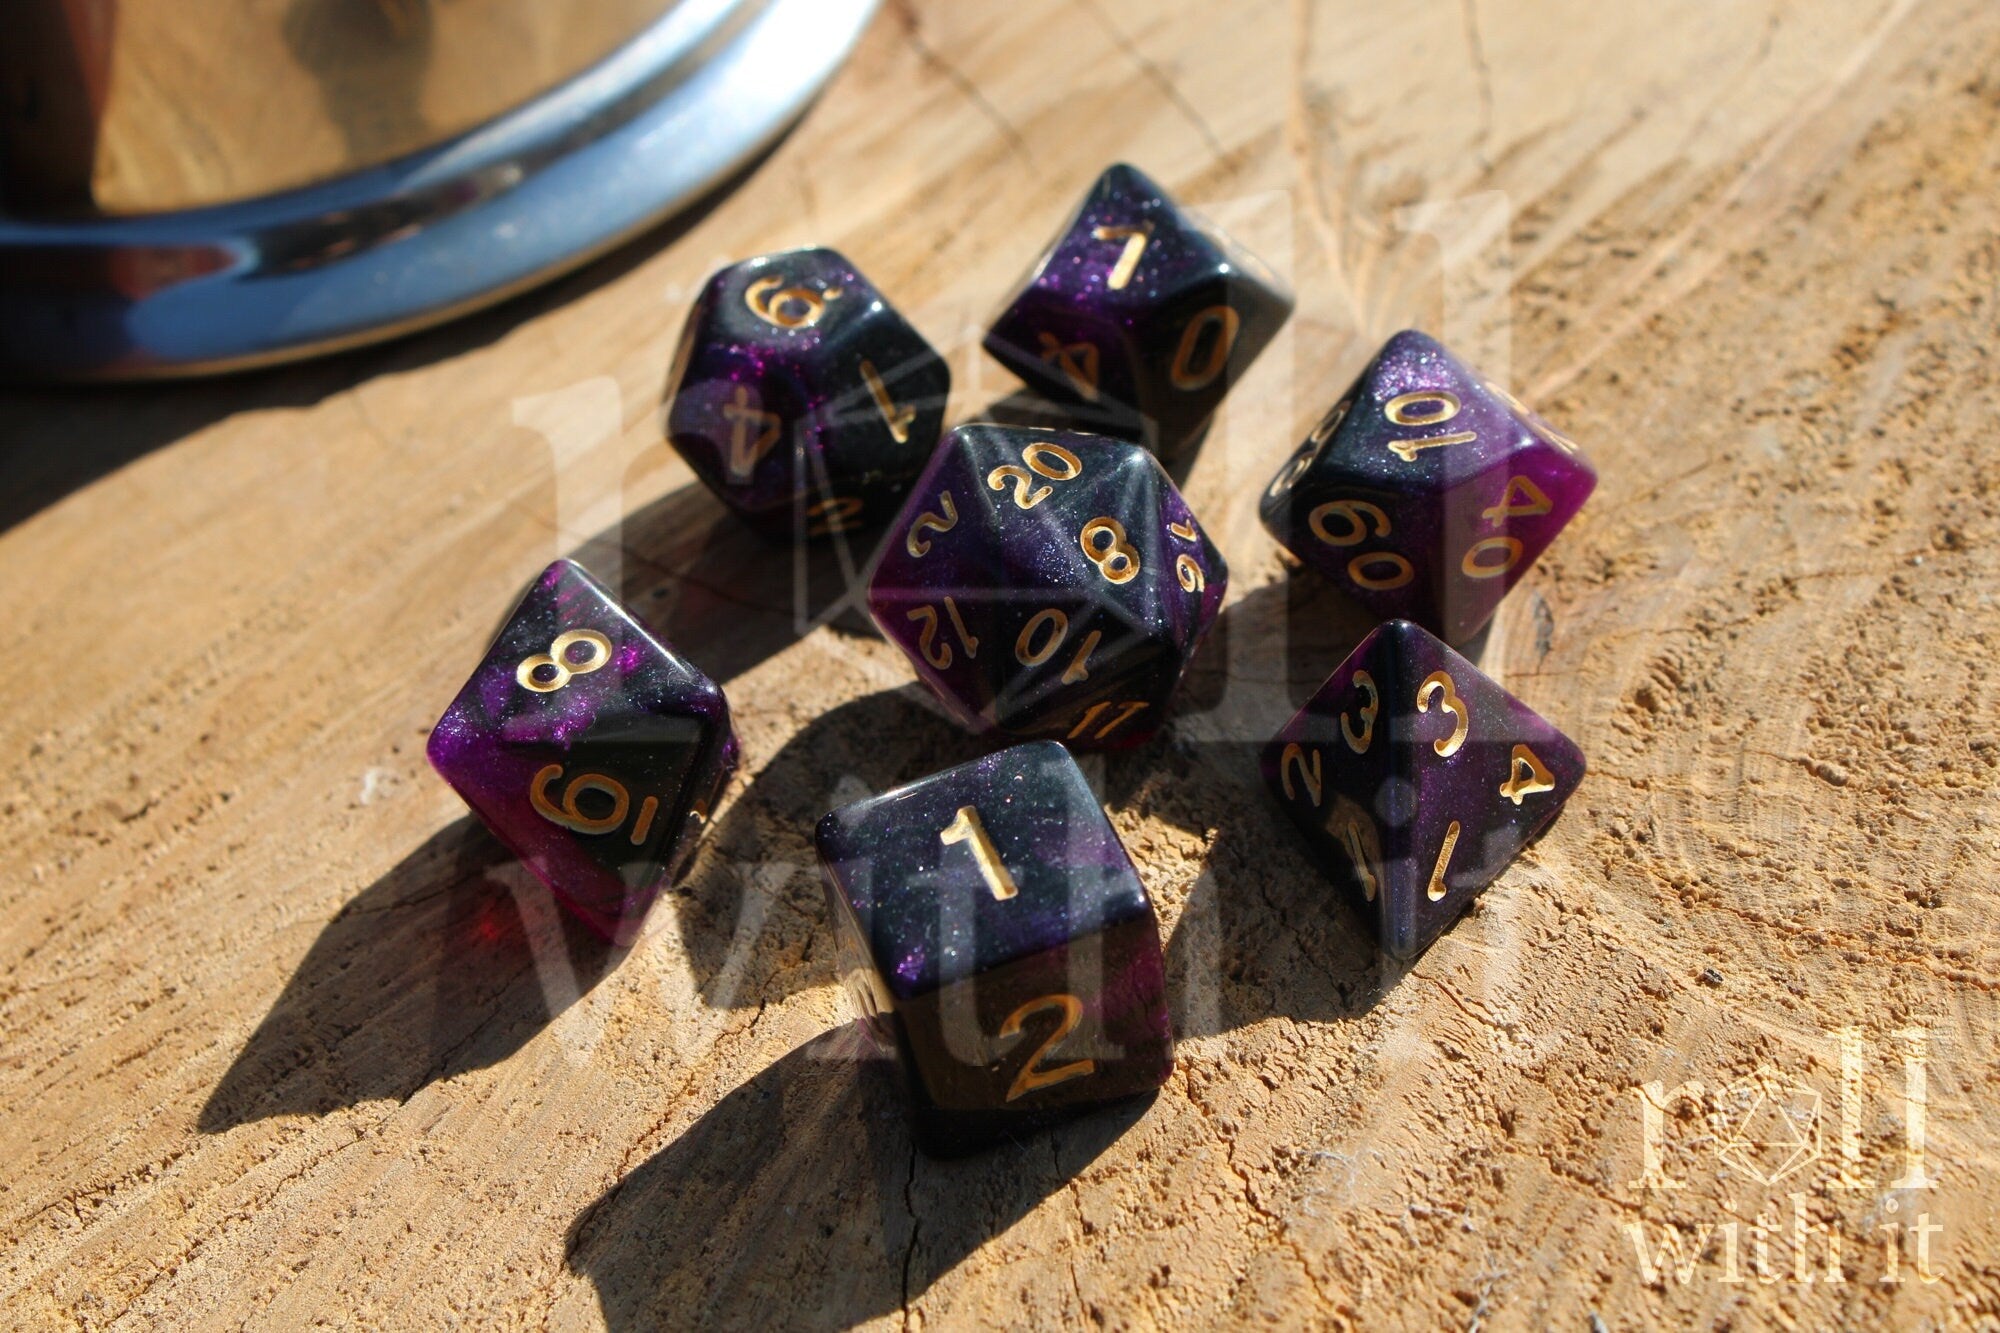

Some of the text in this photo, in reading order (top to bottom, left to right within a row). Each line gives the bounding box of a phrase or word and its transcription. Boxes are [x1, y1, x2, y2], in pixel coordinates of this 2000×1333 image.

[1092, 220, 1154, 289] 7
[723, 386, 782, 476] 4
[860, 358, 916, 443] 1
[1384, 391, 1478, 462] 10
[987, 442, 1082, 509] 20
[907, 490, 958, 557] 2
[1080, 516, 1140, 585] 8
[516, 628, 612, 693] 8
[906, 597, 979, 670] 12
[1015, 608, 1101, 685] 10
[1341, 670, 1379, 754] 3
[1417, 671, 1469, 757] 3
[1281, 742, 1322, 807] 2
[1500, 744, 1555, 806] 4
[940, 804, 1018, 901] 1
[1427, 820, 1461, 902] 1
[1000, 993, 1095, 1102] 2
